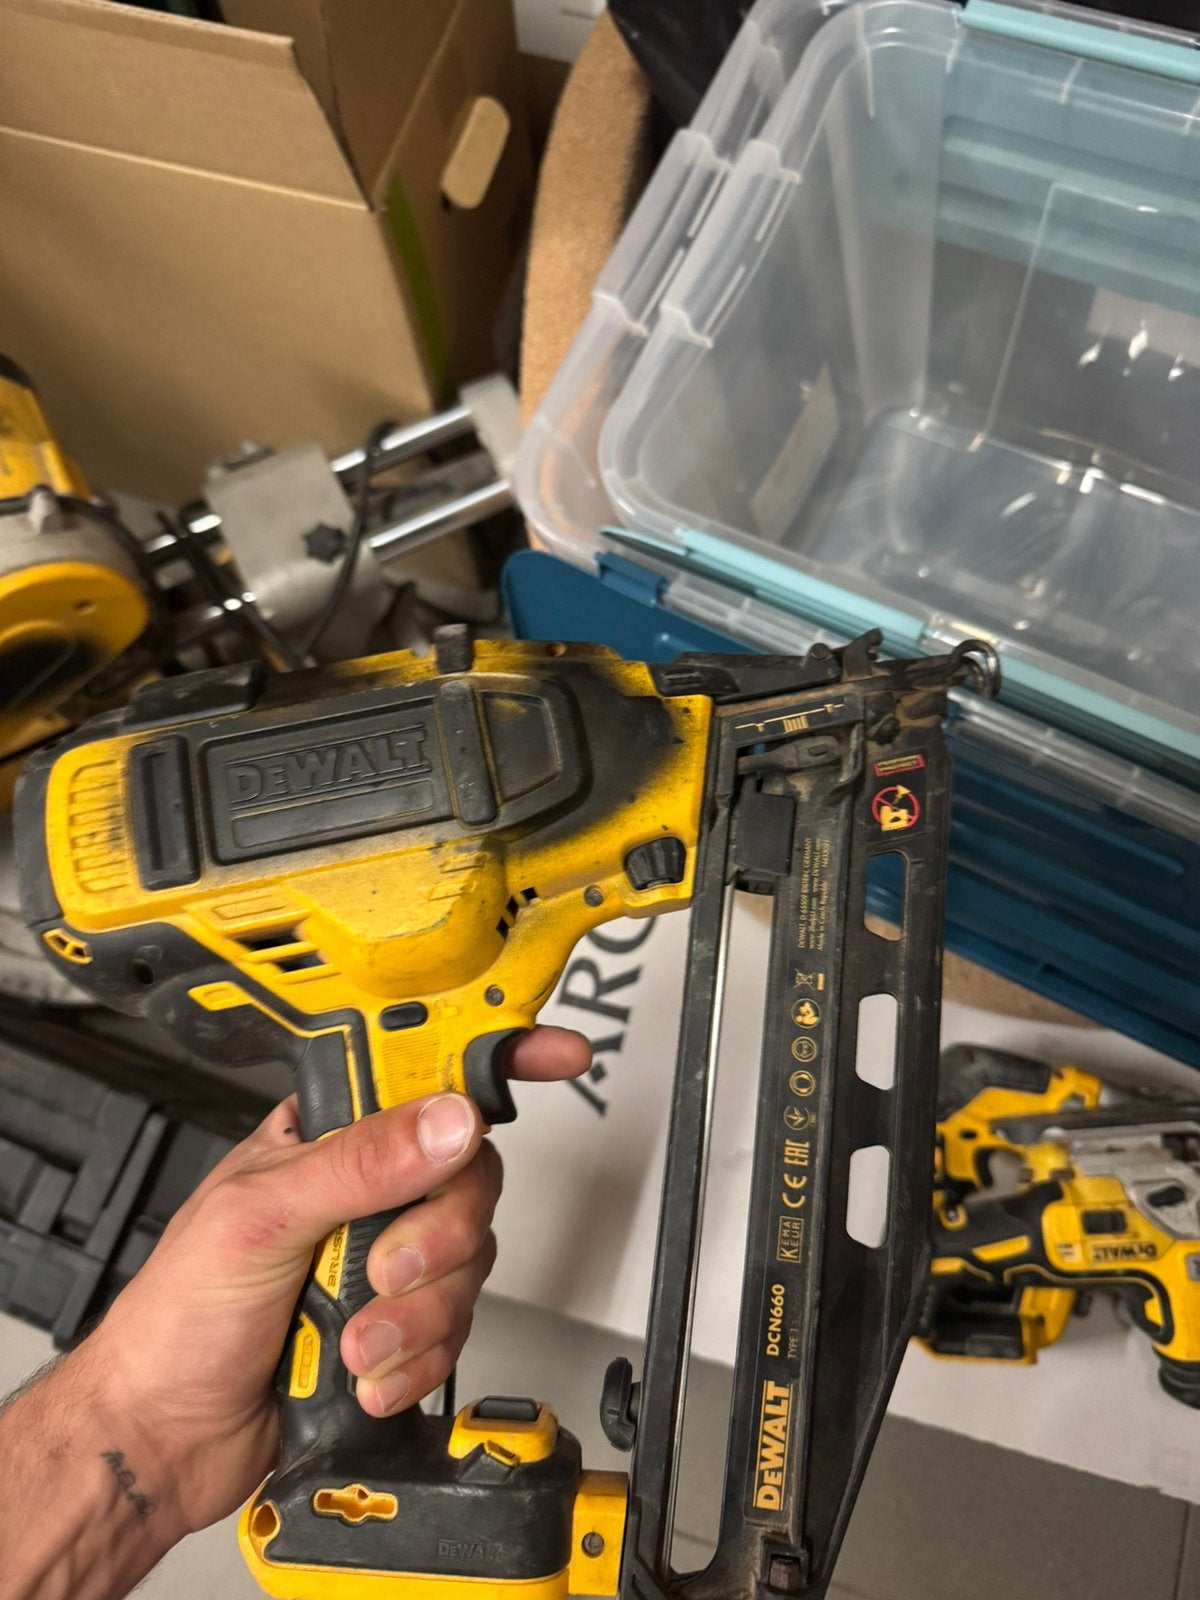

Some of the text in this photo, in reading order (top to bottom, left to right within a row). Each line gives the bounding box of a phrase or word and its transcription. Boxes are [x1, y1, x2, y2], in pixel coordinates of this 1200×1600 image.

[229, 730, 429, 804] DEWALT
[765, 1283, 786, 1357] DCN660
[786, 1335, 799, 1359] TYPE
[755, 1379, 791, 1512] DEWALT
